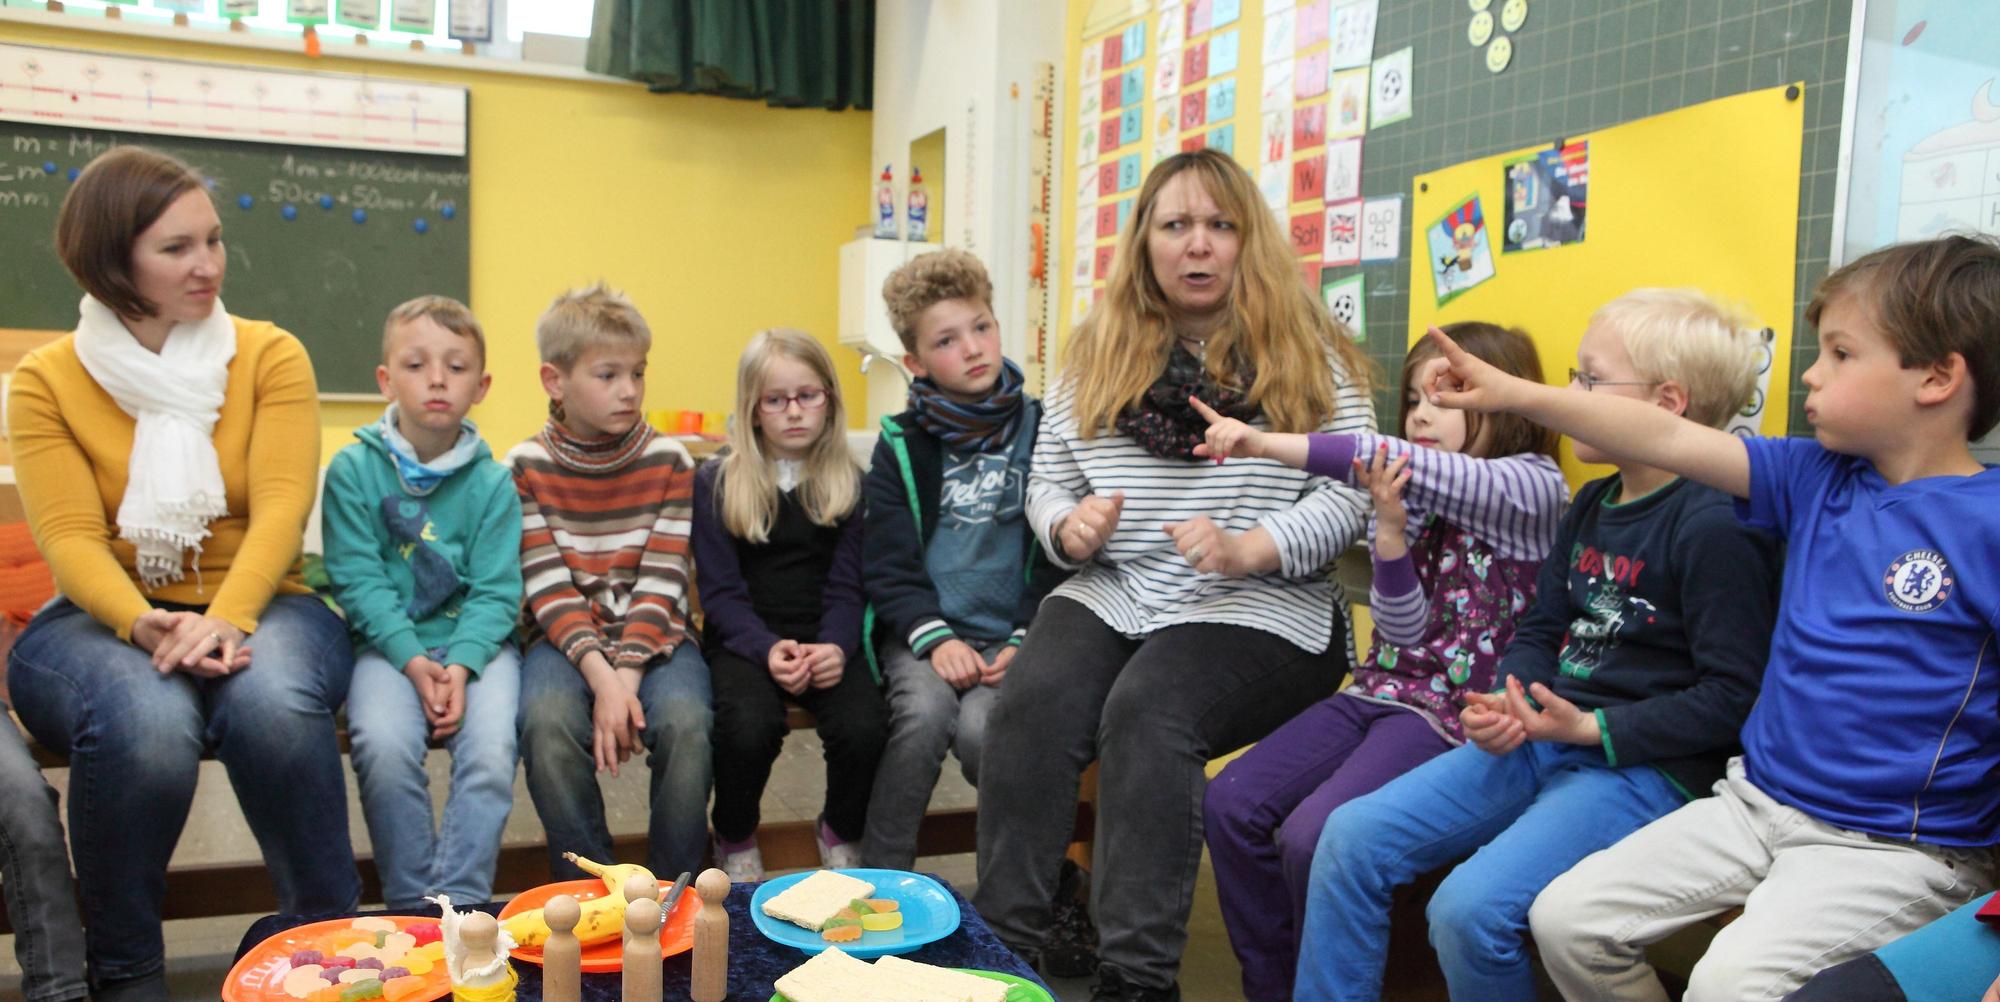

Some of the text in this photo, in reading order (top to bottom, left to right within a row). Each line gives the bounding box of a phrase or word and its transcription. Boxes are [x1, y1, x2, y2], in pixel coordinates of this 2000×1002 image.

[1300, 166, 1316, 192] W
[1291, 224, 1319, 247] Sch
[1905, 551, 1948, 572] CHELSEA
